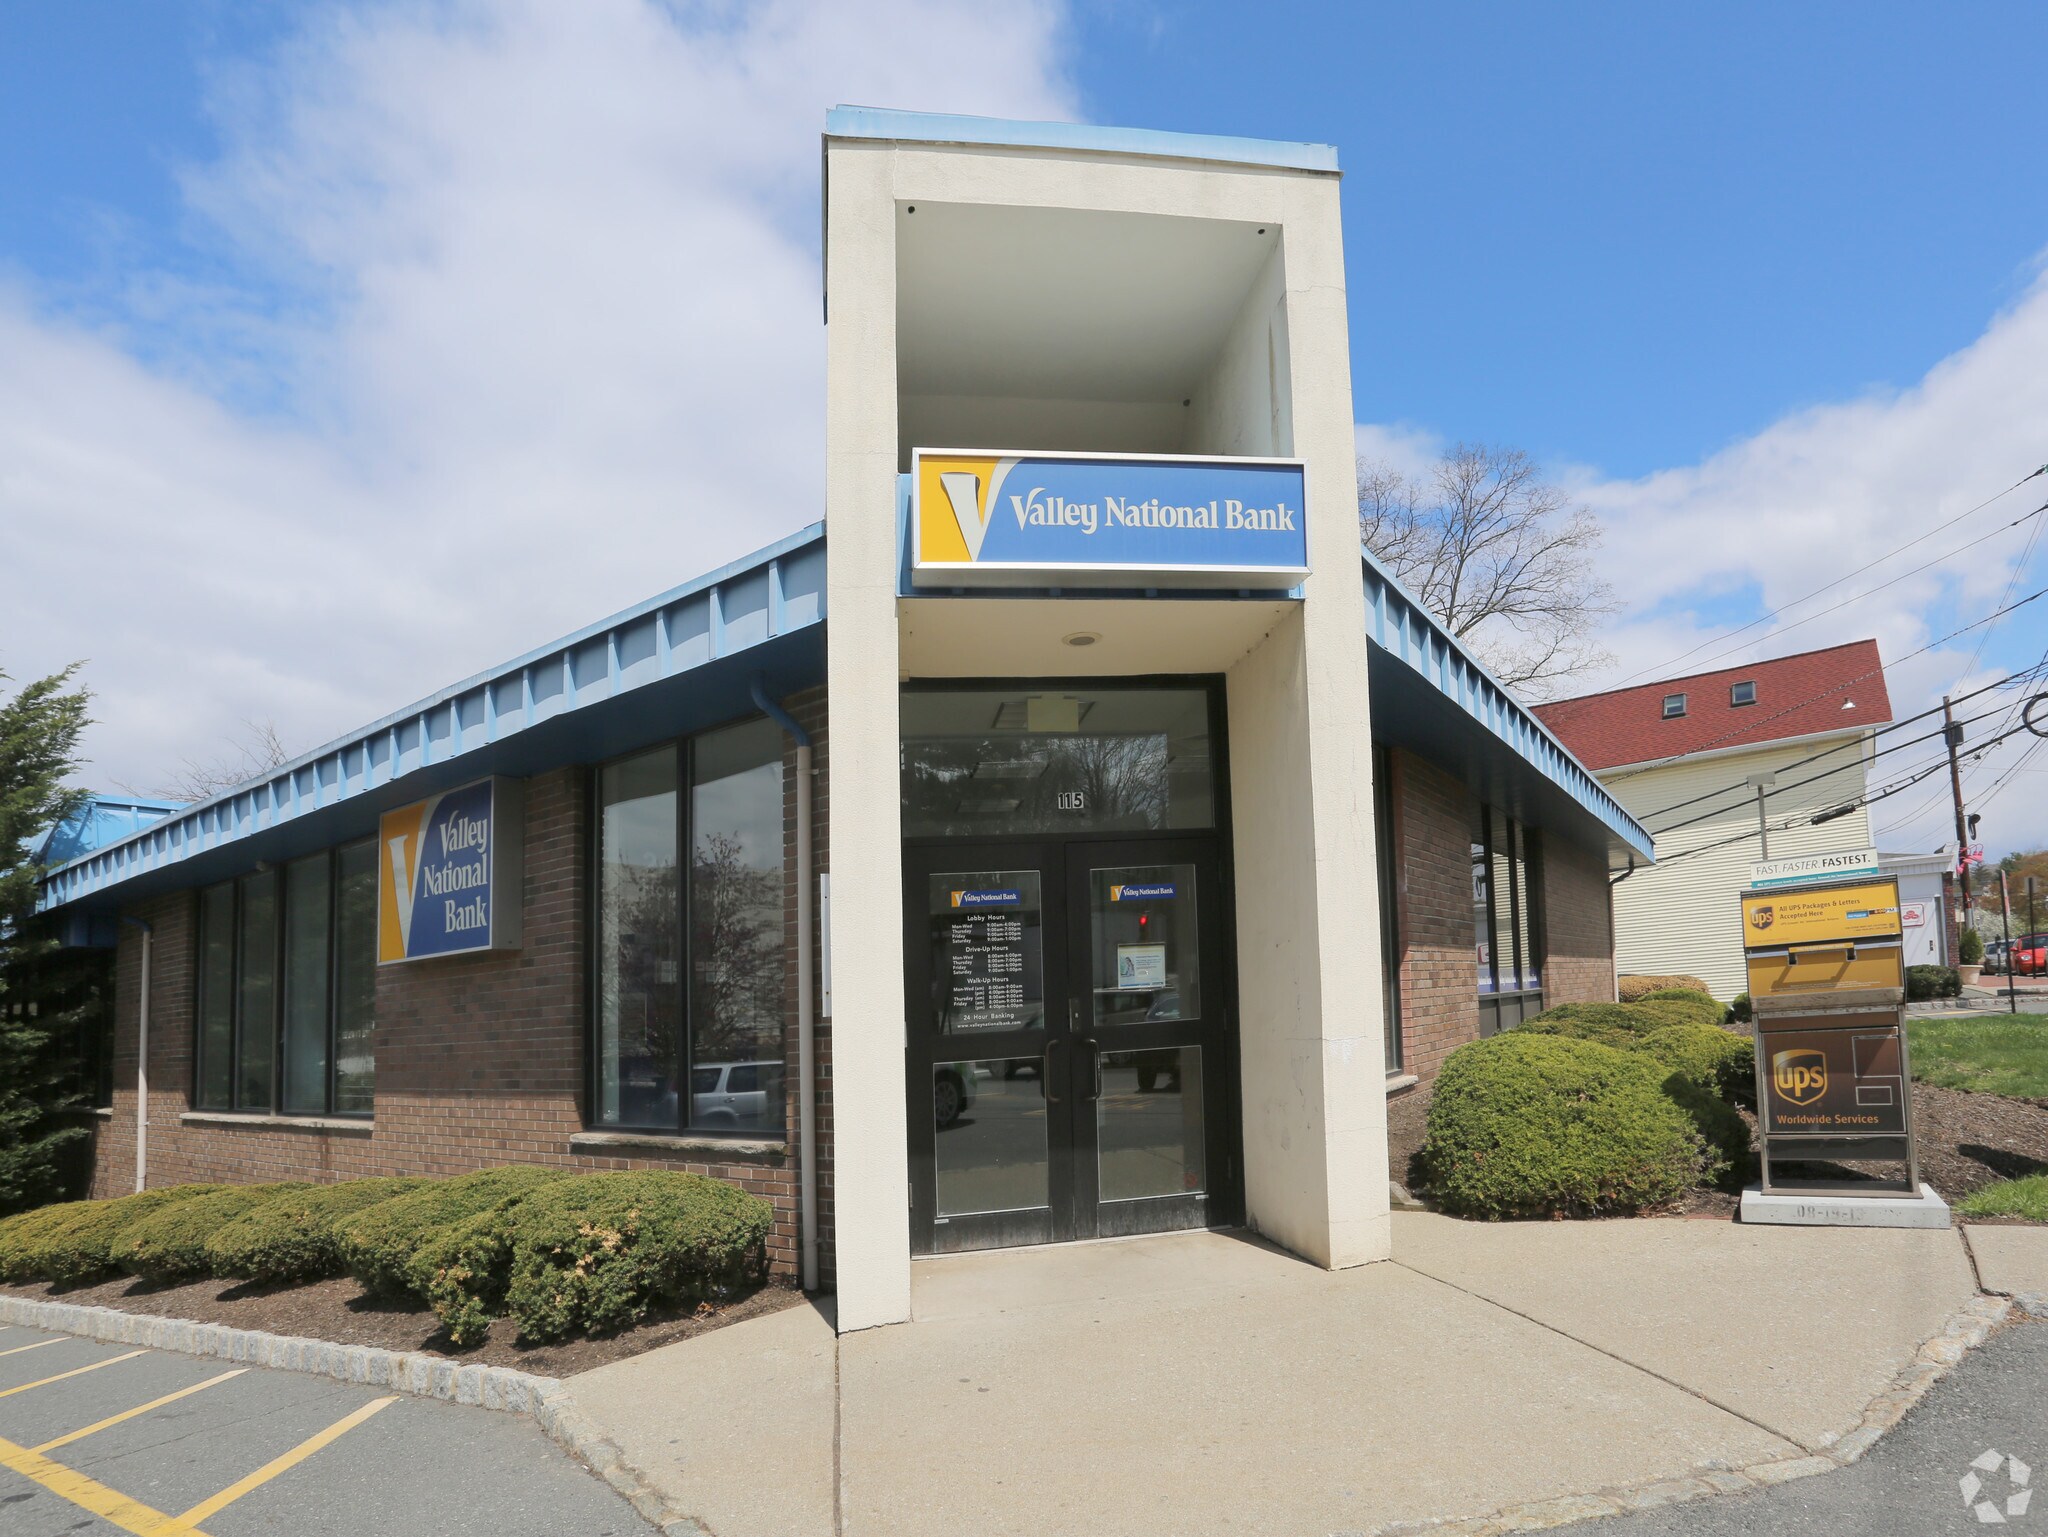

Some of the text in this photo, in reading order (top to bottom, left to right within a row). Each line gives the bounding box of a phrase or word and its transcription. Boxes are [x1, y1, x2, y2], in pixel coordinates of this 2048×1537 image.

[1009, 487, 1296, 534] Valley National Bank
[1058, 793, 1082, 808] 115
[440, 810, 488, 860] Valley
[1756, 854, 1871, 875] FAST. FASTER. FASTEST.
[423, 853, 488, 898] National
[964, 894, 980, 902] Valley
[1123, 887, 1139, 896] Valley
[444, 896, 488, 933] Bank
[1802, 902, 1831, 911] Packages
[1751, 910, 1773, 927] ups
[1779, 912, 1807, 920] Accepted
[1778, 1066, 1824, 1097] ups
[1776, 1114, 1879, 1124] Worldwide Services
